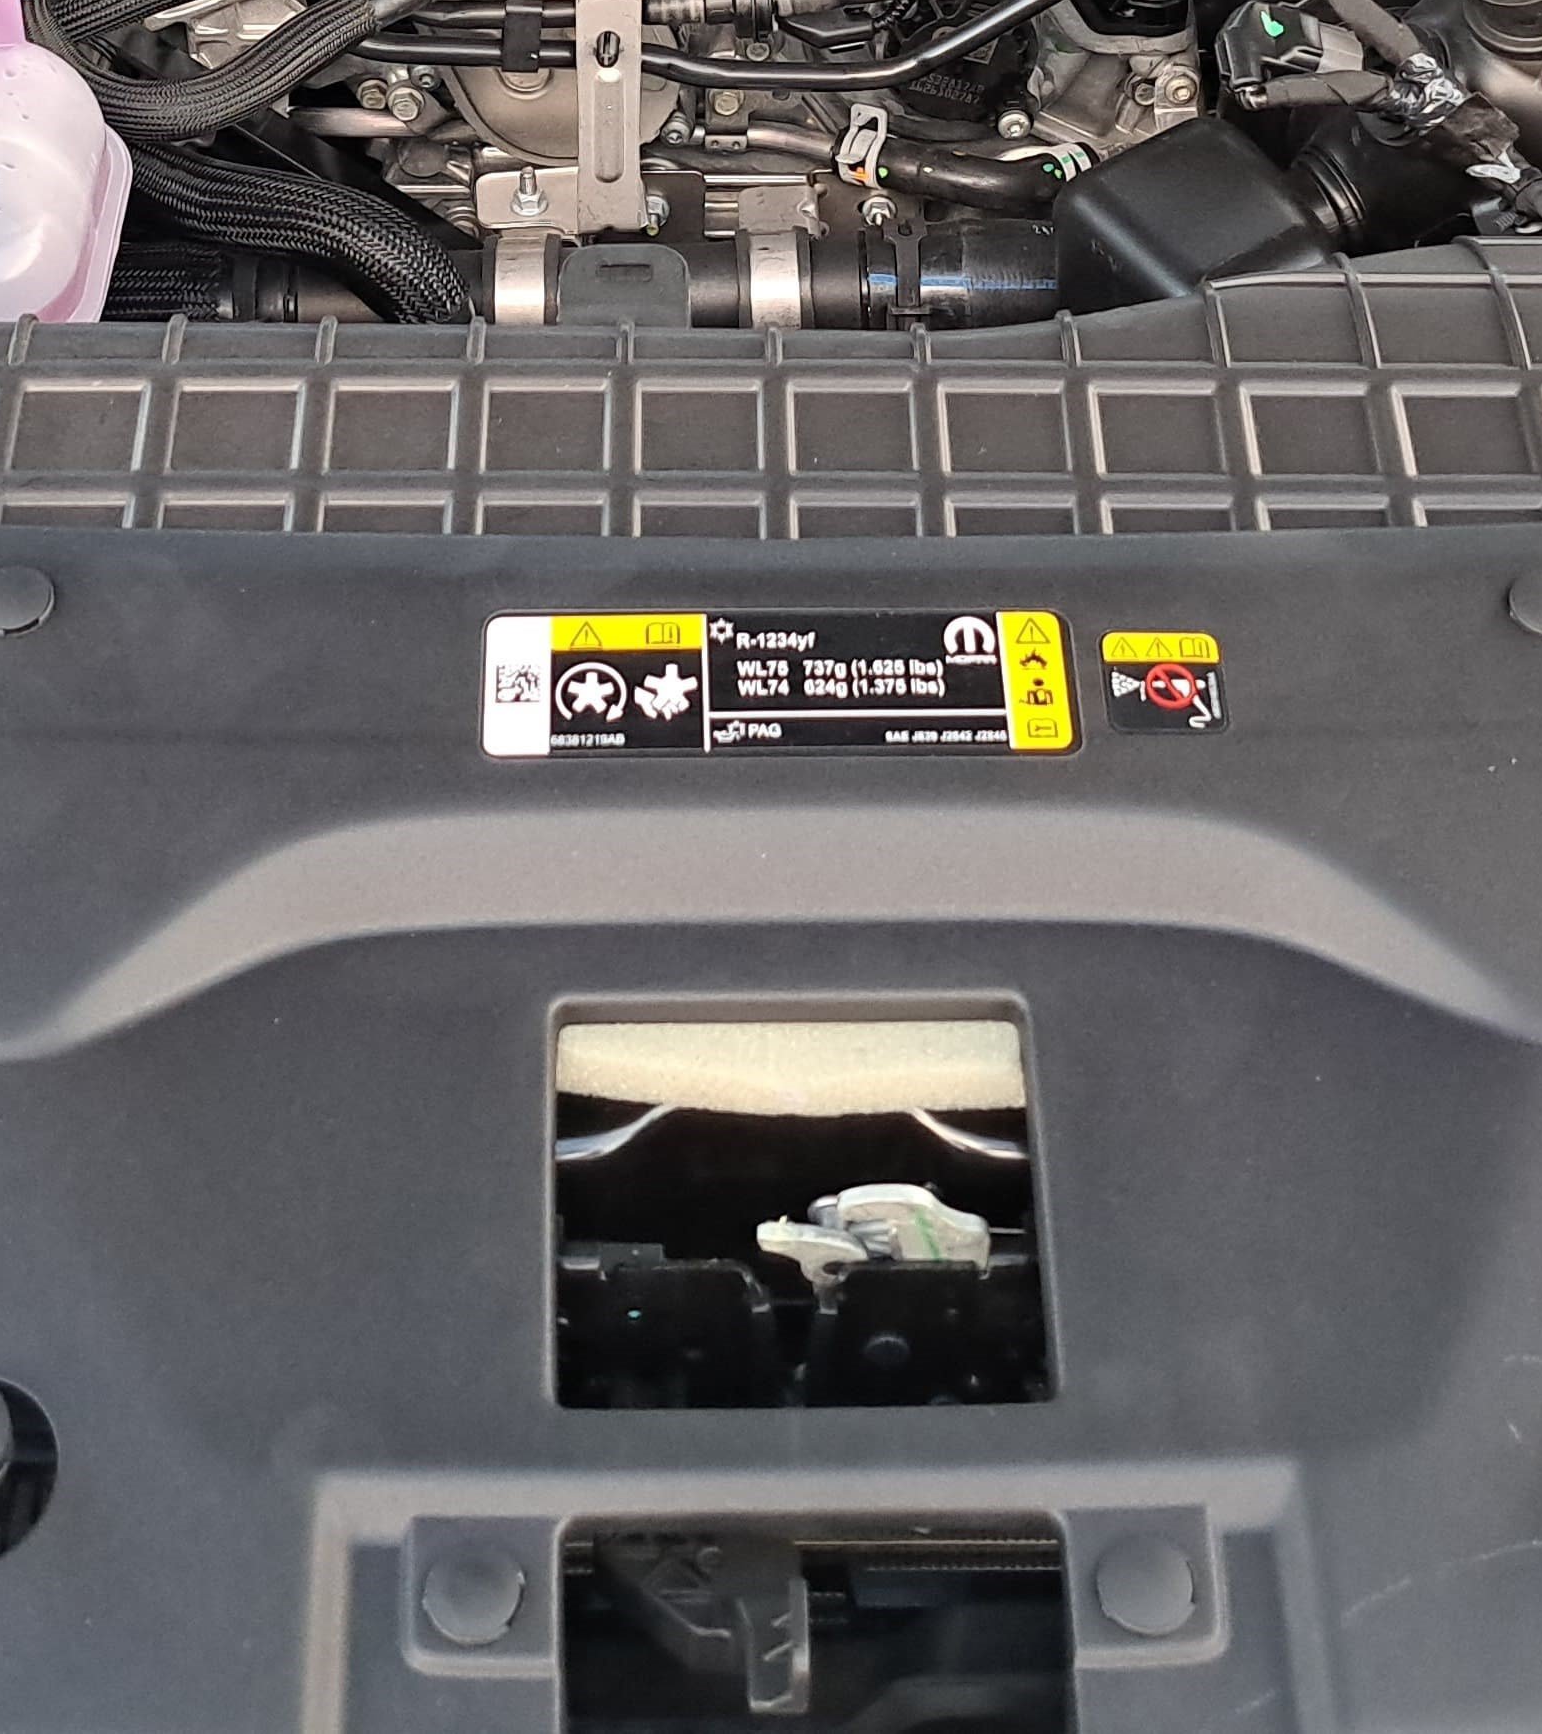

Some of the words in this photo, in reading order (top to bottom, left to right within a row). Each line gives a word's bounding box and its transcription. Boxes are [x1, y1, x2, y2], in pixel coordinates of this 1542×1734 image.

[736, 631, 816, 652] R-1234yf
[736, 659, 790, 677] WL75
[802, 659, 847, 679] 737g
[909, 658, 944, 679] lbs)
[737, 678, 790, 697] WL74
[910, 677, 946, 698] lbs)
[747, 722, 782, 738] PAG
